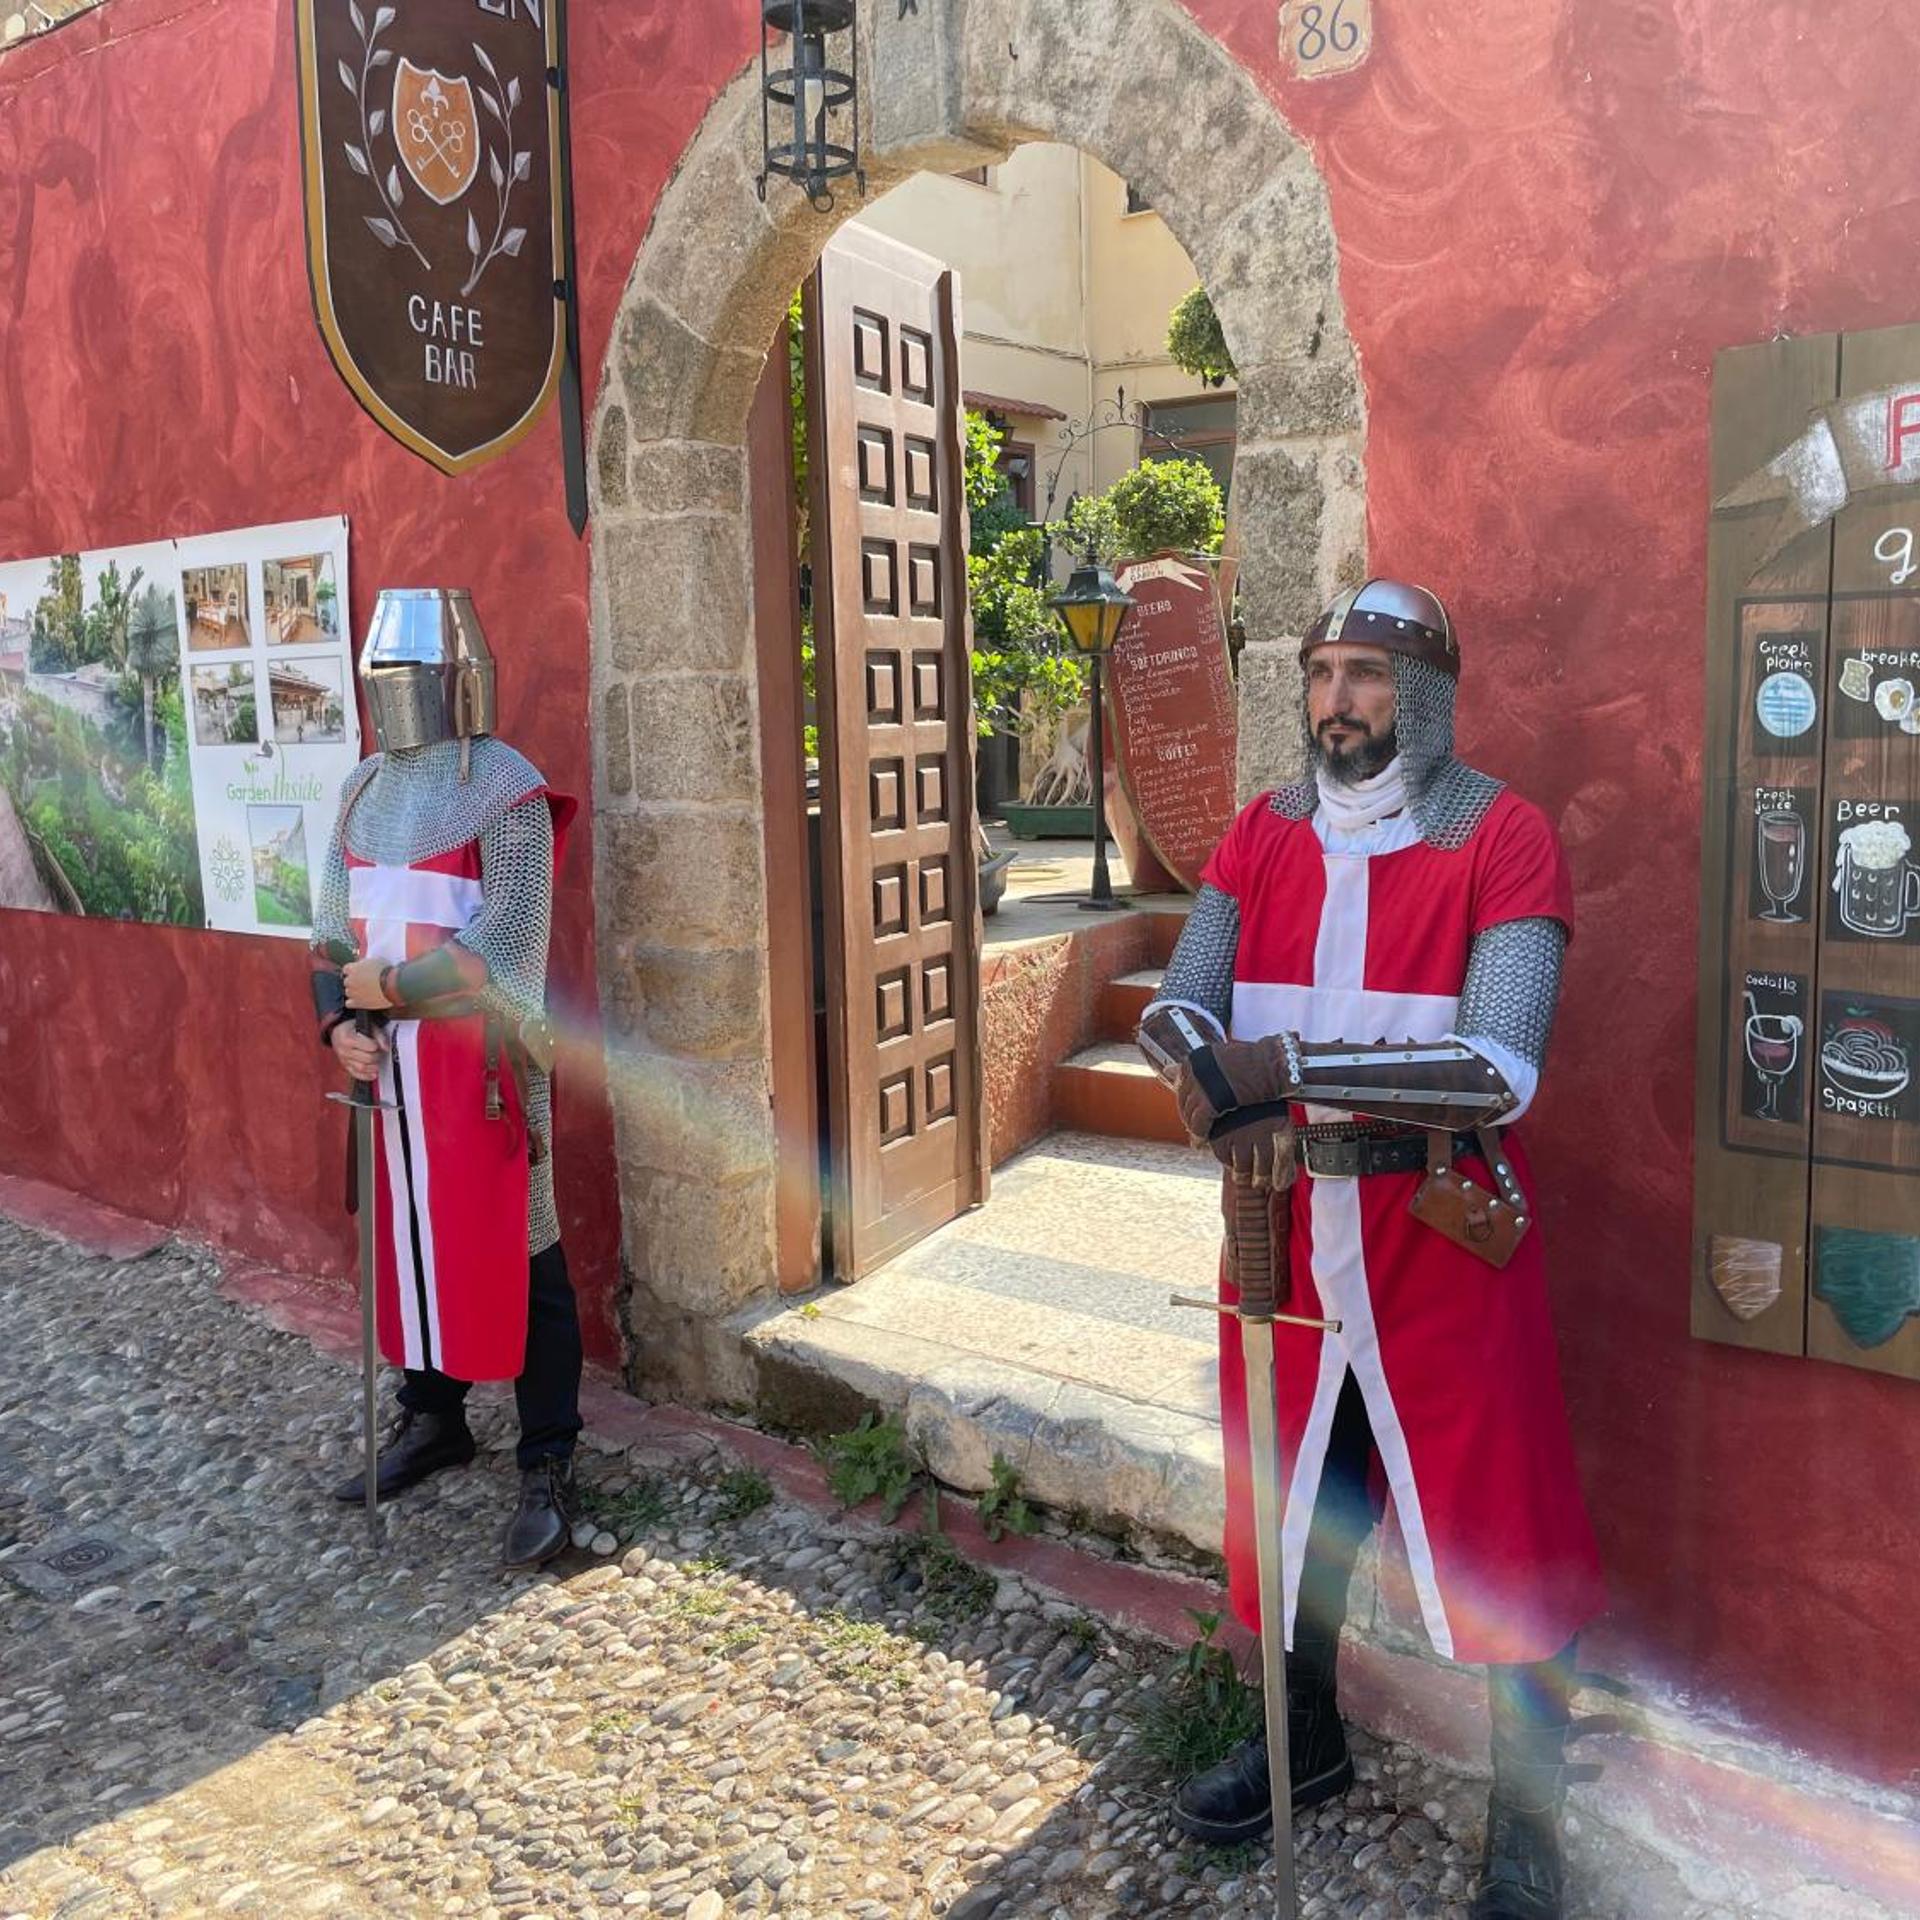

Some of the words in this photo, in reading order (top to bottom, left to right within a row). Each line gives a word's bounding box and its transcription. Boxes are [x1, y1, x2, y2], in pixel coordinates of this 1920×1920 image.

[1299, 0, 1358, 60] 86
[408, 294, 484, 346] CAFE
[425, 344, 477, 390] BAR
[1760, 641, 1809, 659] Greek
[1755, 788, 1796, 800] fresh
[1754, 801, 1792, 815] juice
[1837, 800, 1900, 822] Beer
[1823, 1087, 1896, 1120] Spagetti
